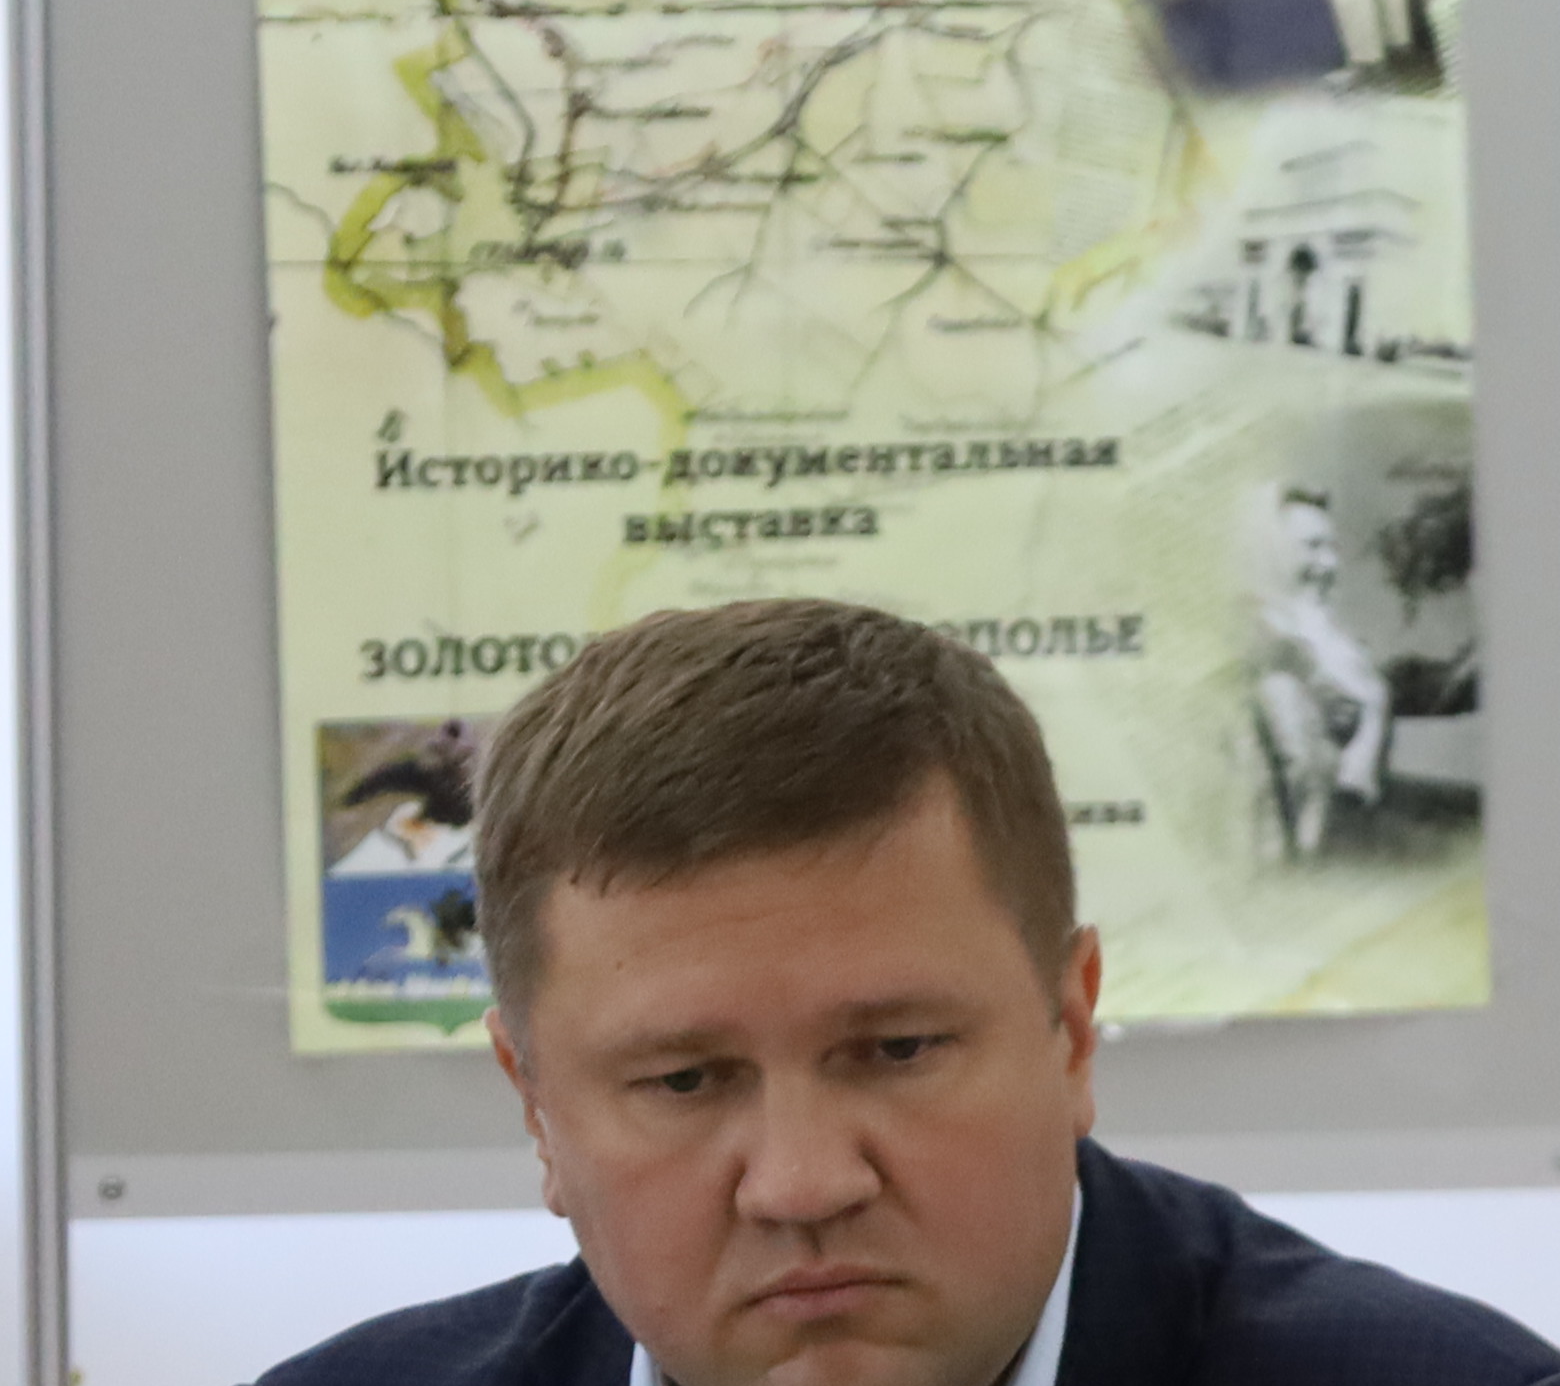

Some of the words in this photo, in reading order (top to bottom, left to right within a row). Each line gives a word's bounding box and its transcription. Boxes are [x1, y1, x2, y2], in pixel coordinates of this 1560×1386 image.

[374, 435, 1121, 496] Историко-документальная
[624, 504, 880, 547] выставка
[359, 631, 594, 680] ЗОЛОТО
[938, 613, 1146, 658] ПОЛЬЕ
